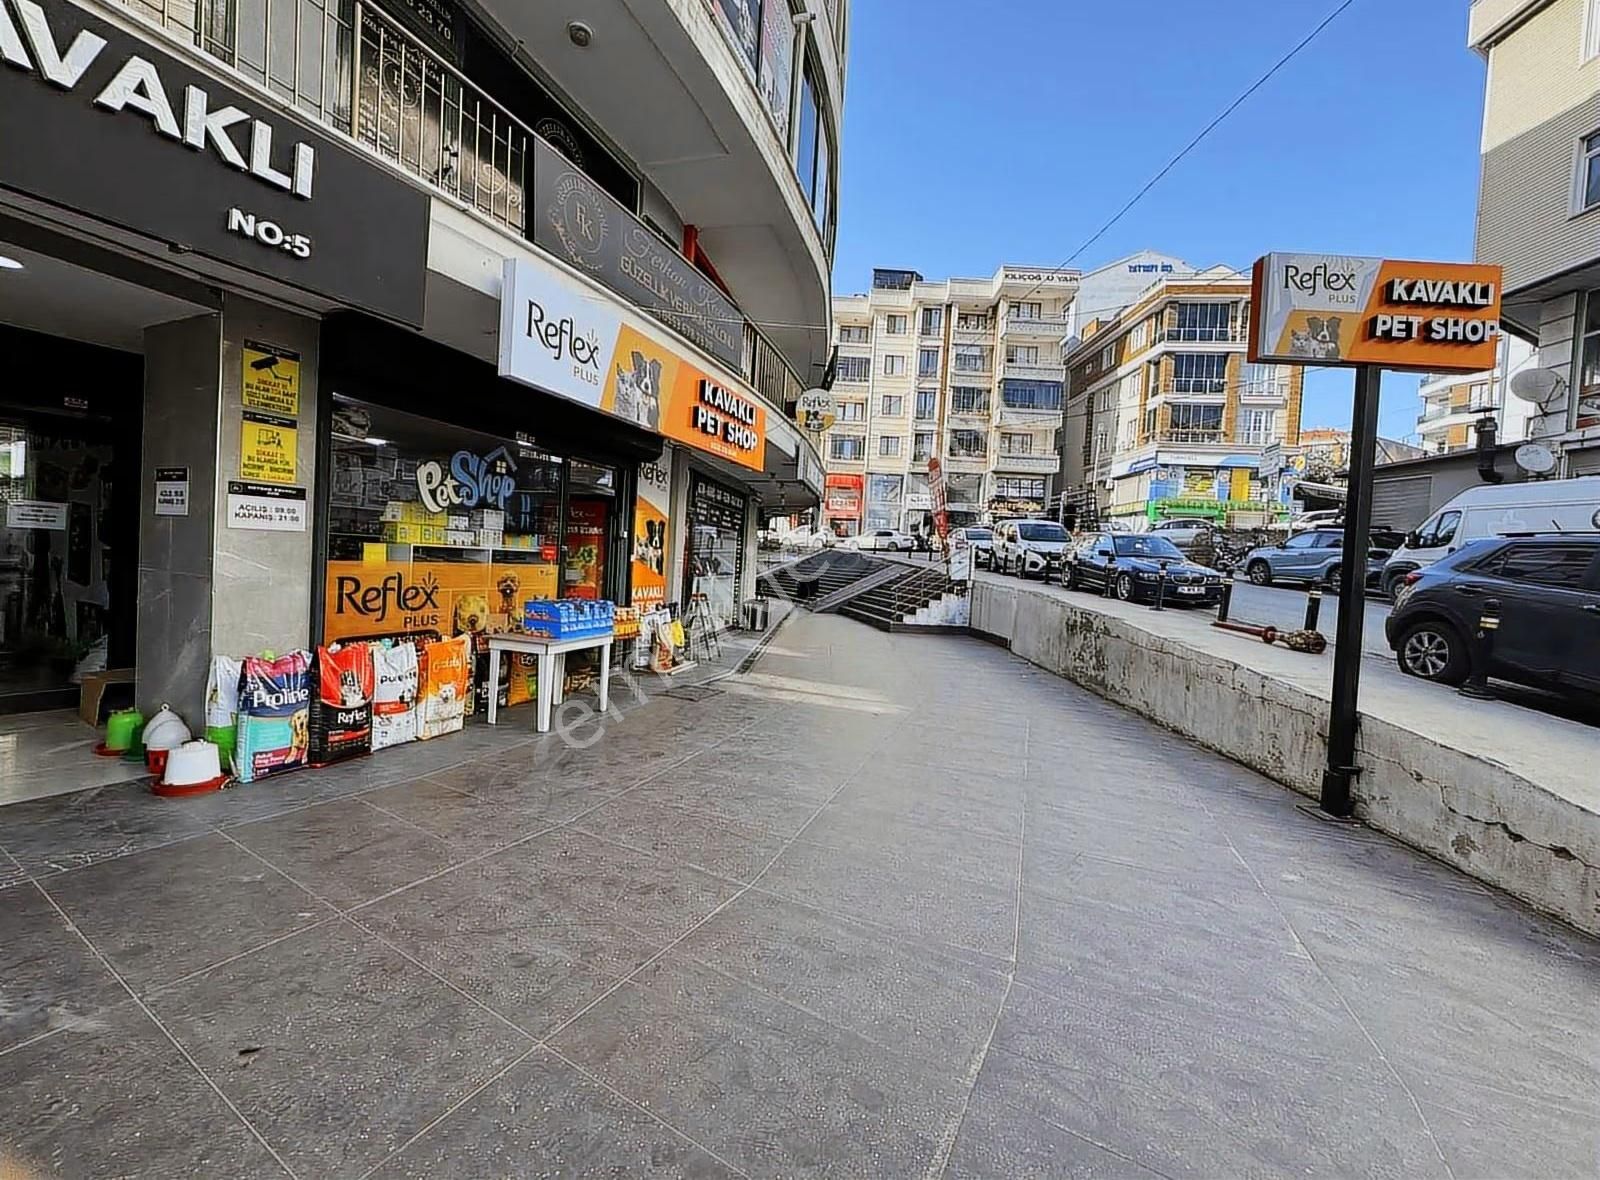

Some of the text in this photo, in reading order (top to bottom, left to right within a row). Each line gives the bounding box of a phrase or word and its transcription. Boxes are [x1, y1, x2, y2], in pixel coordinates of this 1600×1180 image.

[1283, 262, 1356, 296] Reflex
[1391, 277, 1496, 305] KAVAKLI
[1328, 294, 1356, 304] PLUS
[526, 299, 600, 370] Reflex
[1375, 314, 1501, 342] PET SHOP
[573, 365, 599, 386] PLUS
[703, 379, 757, 427] KAVAKLI
[696, 405, 724, 436] PET
[727, 421, 758, 452] SHOP
[335, 571, 440, 623] Reflex
[403, 614, 439, 629] PLUS
